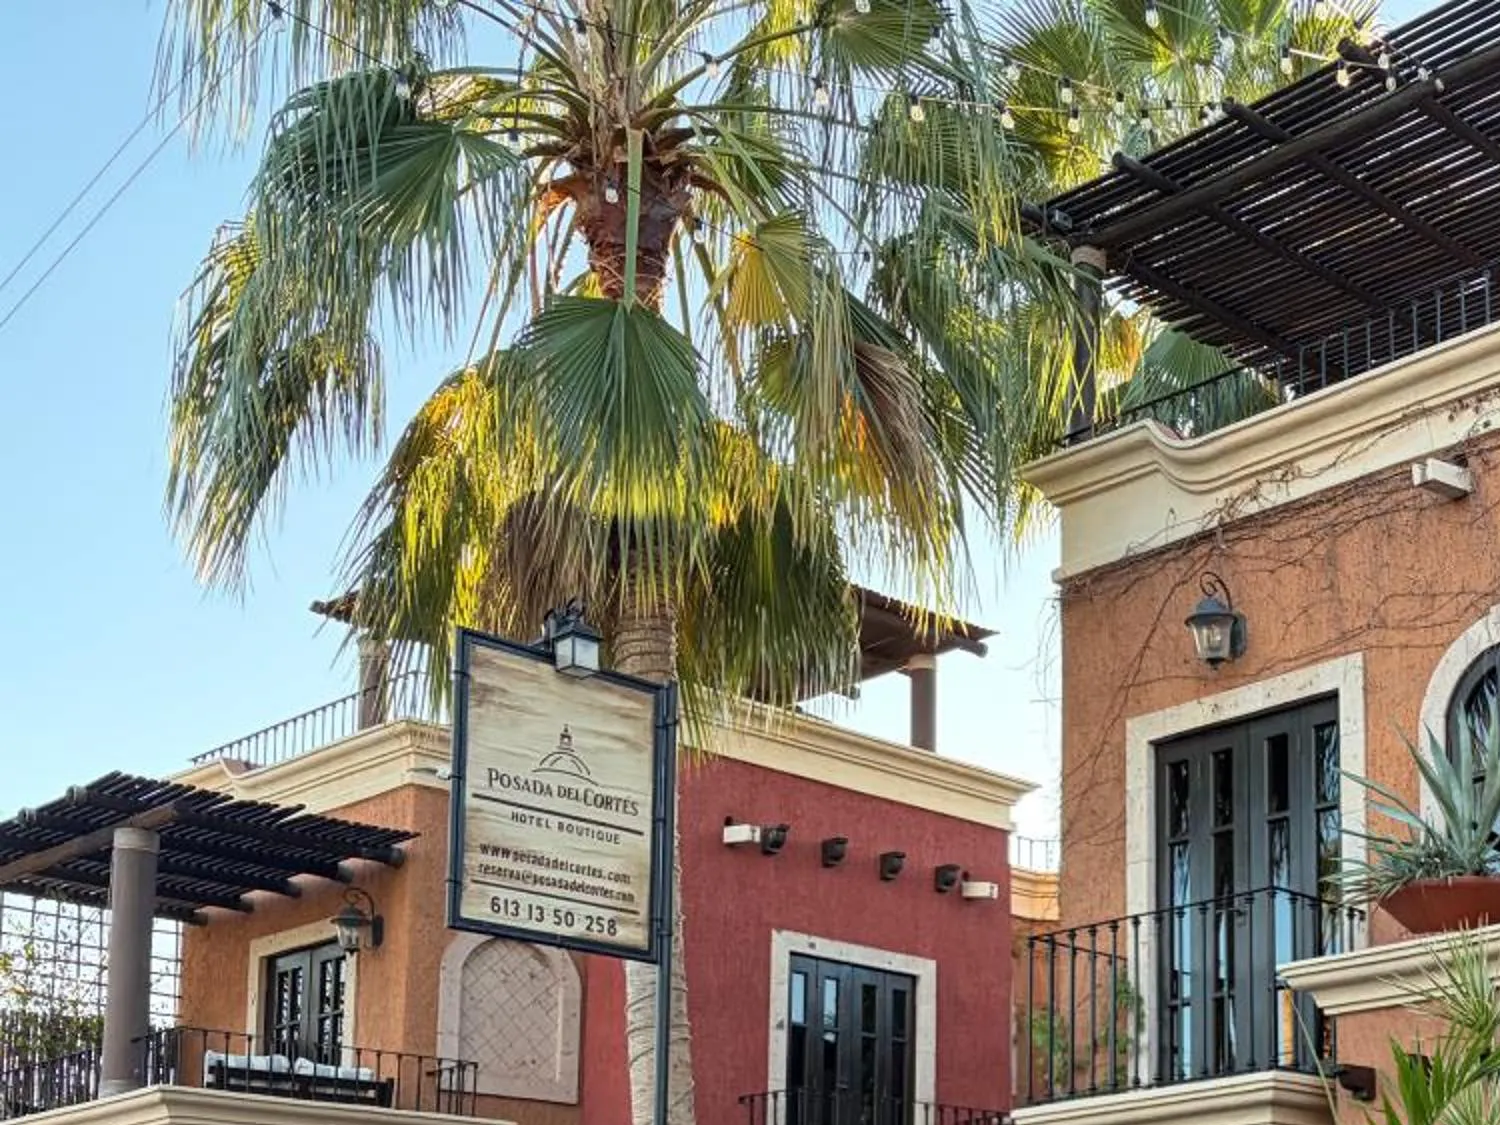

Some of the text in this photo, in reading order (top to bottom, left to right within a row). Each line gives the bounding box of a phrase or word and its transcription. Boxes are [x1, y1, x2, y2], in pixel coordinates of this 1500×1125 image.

[487, 768, 553, 798] POSADA
[583, 788, 640, 817] CORTÉS
[511, 811, 621, 844] HOTEL BOUTIQUE
[490, 896, 618, 937] 613 13 50 258
